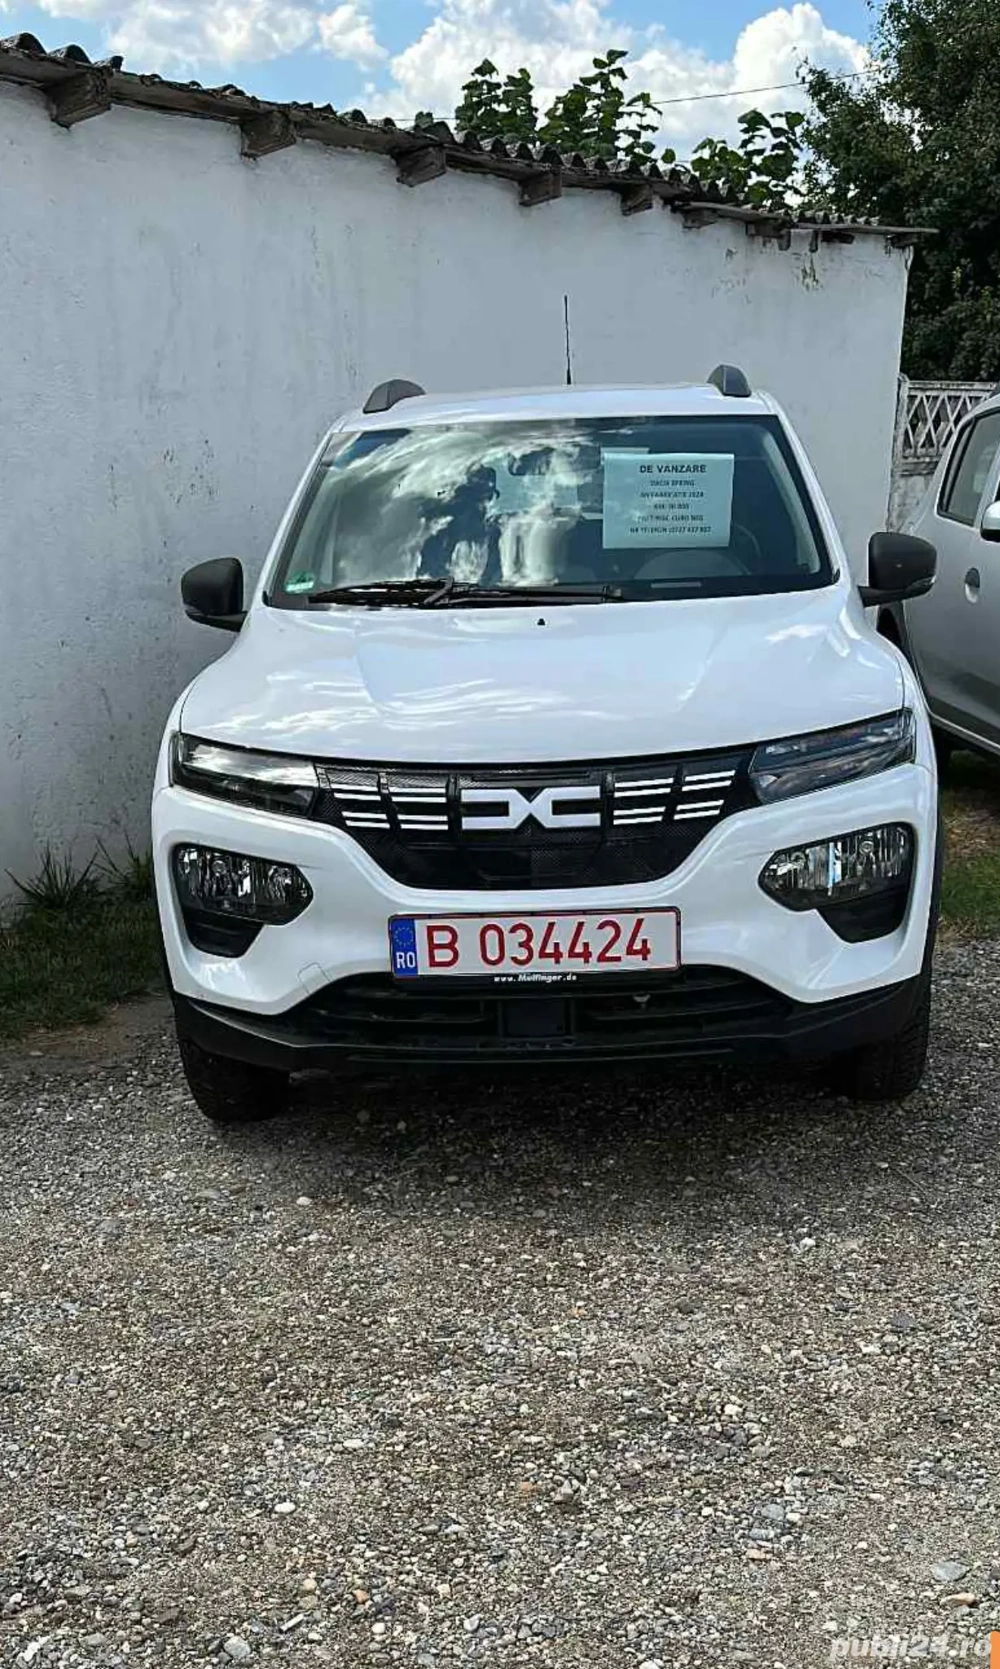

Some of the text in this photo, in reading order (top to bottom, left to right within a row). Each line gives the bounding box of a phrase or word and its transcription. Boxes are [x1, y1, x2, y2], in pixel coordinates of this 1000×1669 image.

[639, 464, 707, 474] DE VANZARE
[426, 918, 652, 968] B 034424
[396, 951, 416, 969] RO
